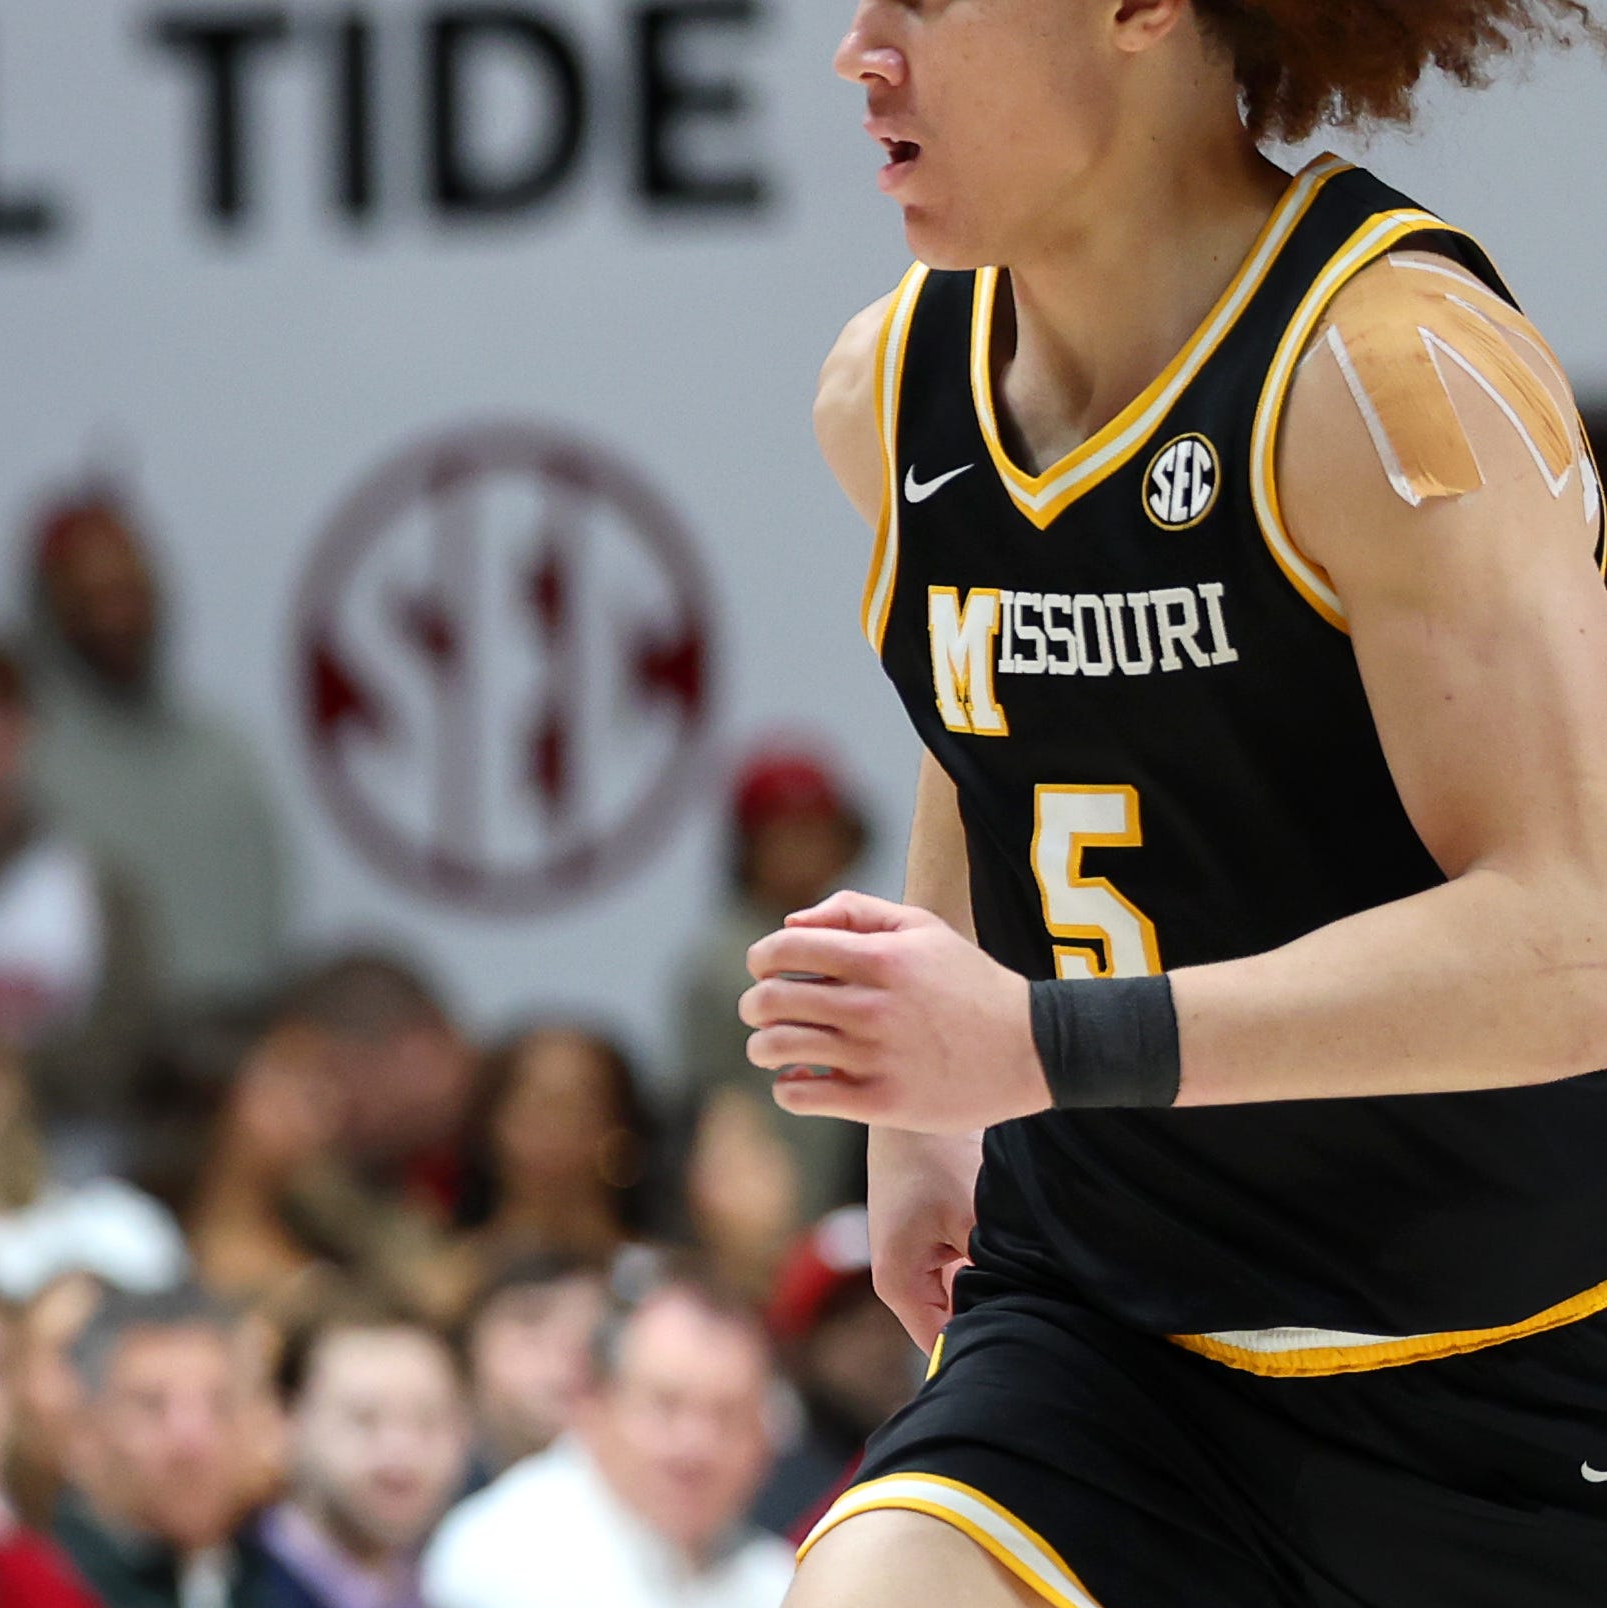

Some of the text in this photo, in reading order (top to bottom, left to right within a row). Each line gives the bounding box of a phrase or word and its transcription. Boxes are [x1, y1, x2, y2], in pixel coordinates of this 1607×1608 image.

[149, 2, 777, 232] TIDE
[1147, 439, 1215, 523] SEC
[317, 468, 703, 893] SEC
[927, 582, 1239, 737] MISSOURI
[1029, 783, 1168, 980] 5
